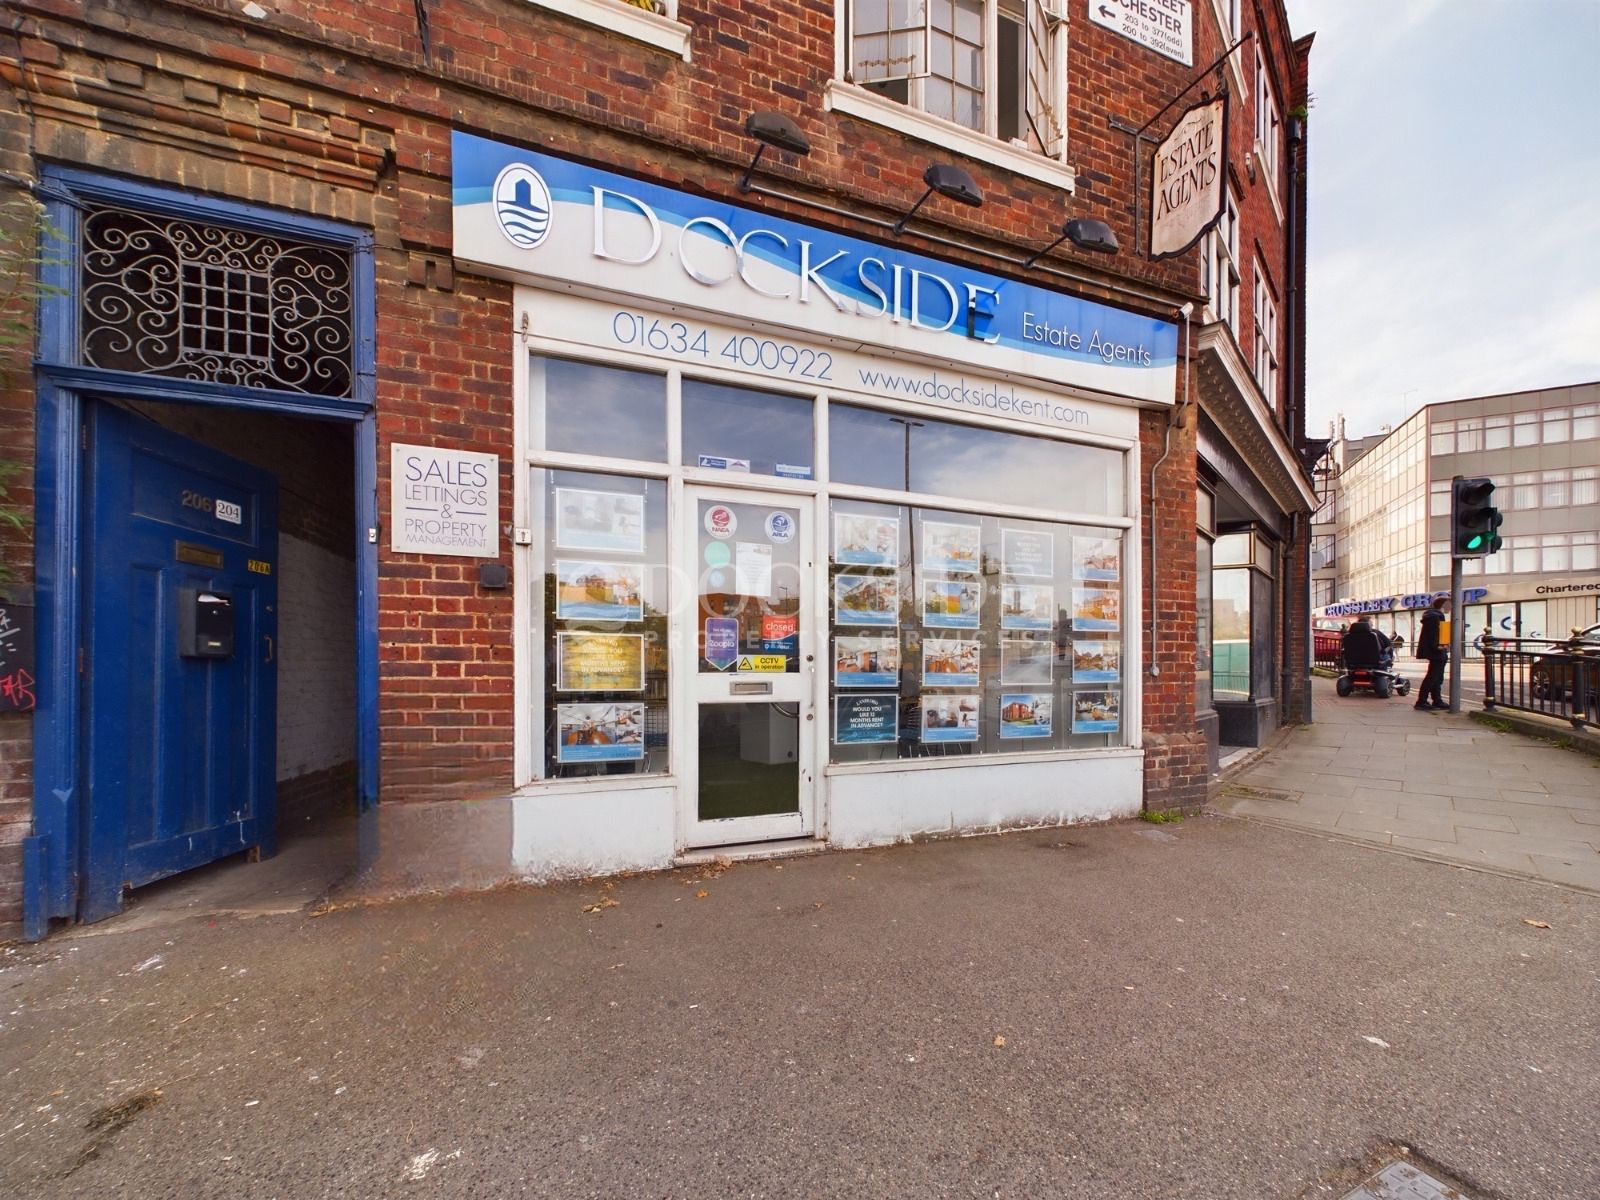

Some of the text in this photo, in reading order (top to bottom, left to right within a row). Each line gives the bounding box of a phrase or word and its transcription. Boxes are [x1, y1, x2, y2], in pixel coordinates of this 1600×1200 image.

[1112, 0, 1182, 35] CHESTER
[1124, 13, 1183, 48] 203 to 377(odd)
[1122, 23, 1185, 59] 200 to 392(even)
[1160, 120, 1214, 184] ESTATE
[1157, 151, 1217, 220] AGENTS
[589, 184, 1001, 345] DOCKSIDE
[613, 311, 833, 381] 01634 400922
[1022, 311, 1151, 367] Estate Agents
[858, 369, 1090, 426] www.docksidekent.com
[405, 456, 488, 488] SALES
[182, 490, 212, 513] 206
[217, 502, 239, 519] 204
[404, 483, 488, 507] LETTINGS
[440, 503, 453, 519] &
[404, 518, 488, 537] PROPERTY
[405, 534, 487, 548] MANAGEMENT
[766, 621, 795, 632] closed
